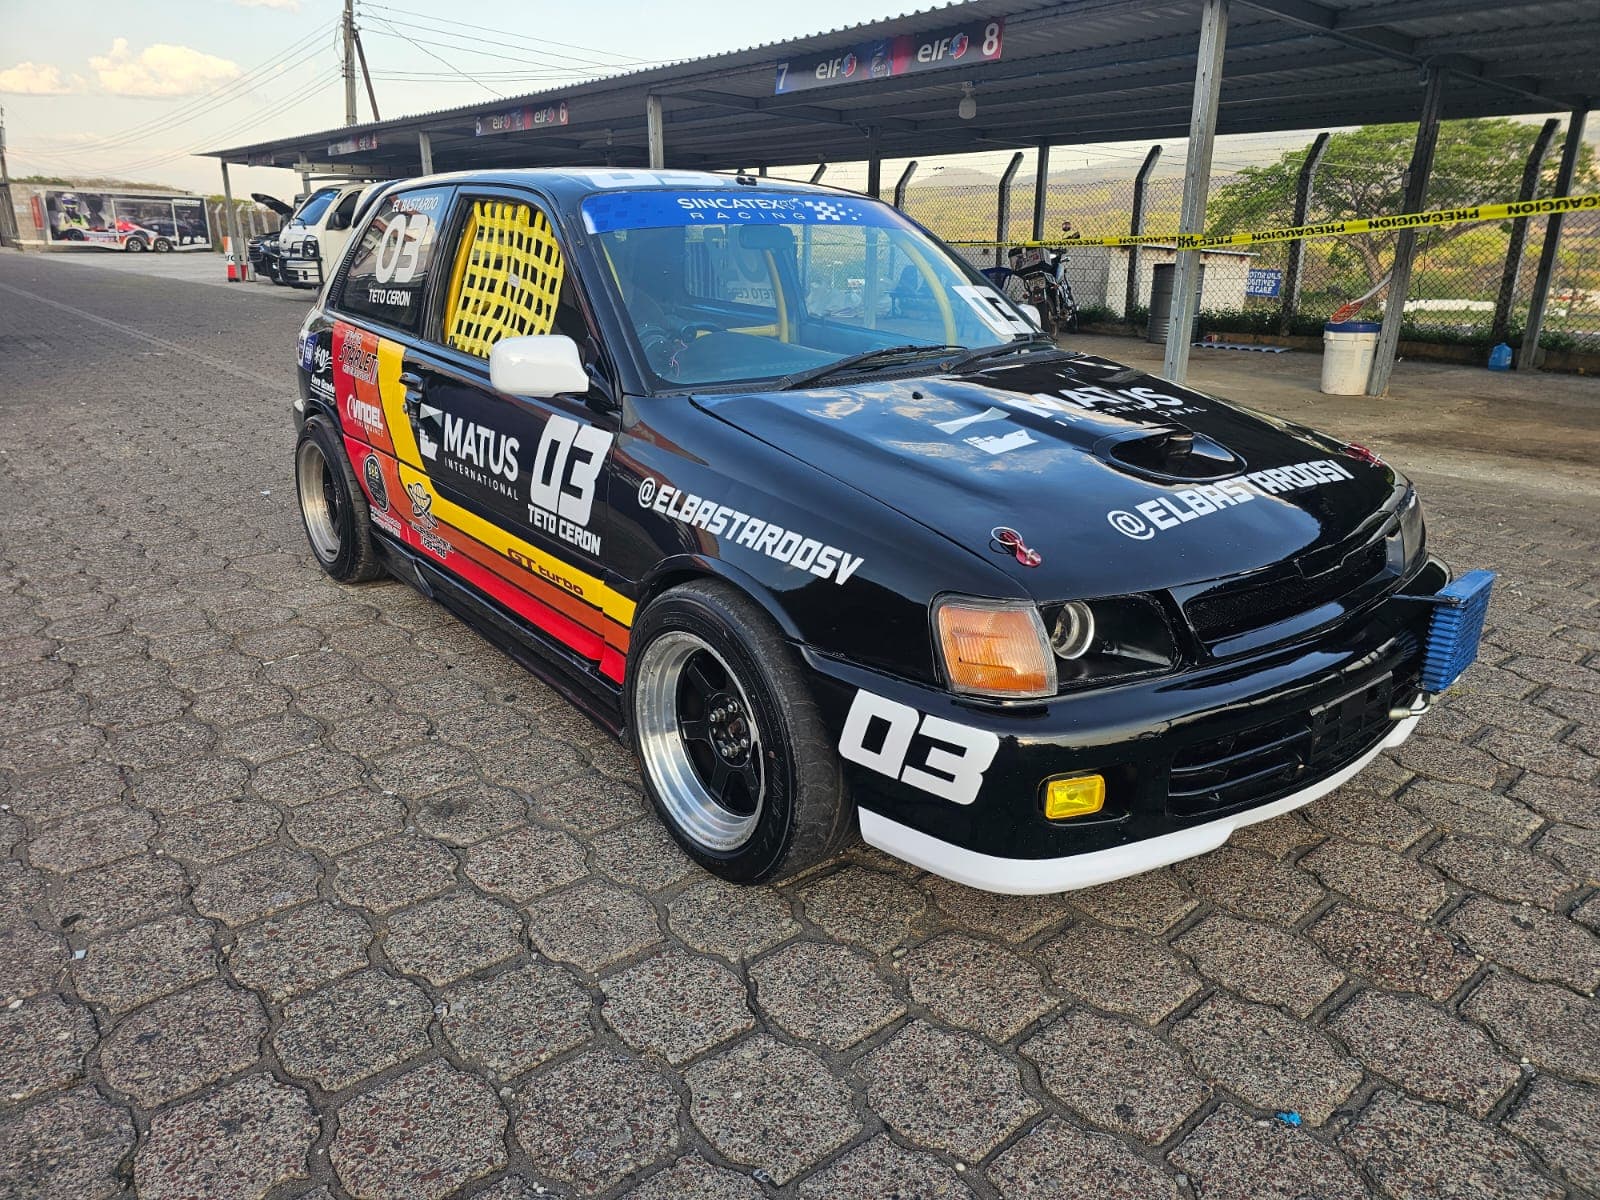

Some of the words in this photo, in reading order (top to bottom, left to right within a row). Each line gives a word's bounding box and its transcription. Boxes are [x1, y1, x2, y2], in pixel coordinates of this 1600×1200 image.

[917, 38, 950, 63] elf
[982, 22, 1000, 56] 8
[777, 62, 789, 90] 7
[815, 58, 843, 80] elf
[492, 115, 504, 130] elf
[534, 108, 548, 124] elf
[559, 102, 566, 122] 6
[677, 198, 779, 210] SINCATEX
[689, 212, 807, 221] RACING
[1368, 208, 1480, 230] PRECAUCION
[1506, 195, 1600, 216] CAUCION
[375, 214, 429, 284] 03
[1251, 223, 1346, 242] PRECAUCION
[368, 288, 386, 303] TETO
[386, 289, 412, 306] CERON
[1003, 385, 1184, 419] MATUS
[444, 412, 520, 482] MATUS
[445, 457, 519, 500] INTERNATIONAL
[530, 413, 614, 527] 03
[1107, 460, 1354, 540] @ELBASTARDOSV
[527, 503, 557, 535] TETO
[558, 519, 601, 556] CERON
[638, 477, 865, 586] @ELBASTARDOSV
[507, 547, 536, 570] GT
[538, 565, 584, 596] turbo
[838, 688, 1000, 806] 03
